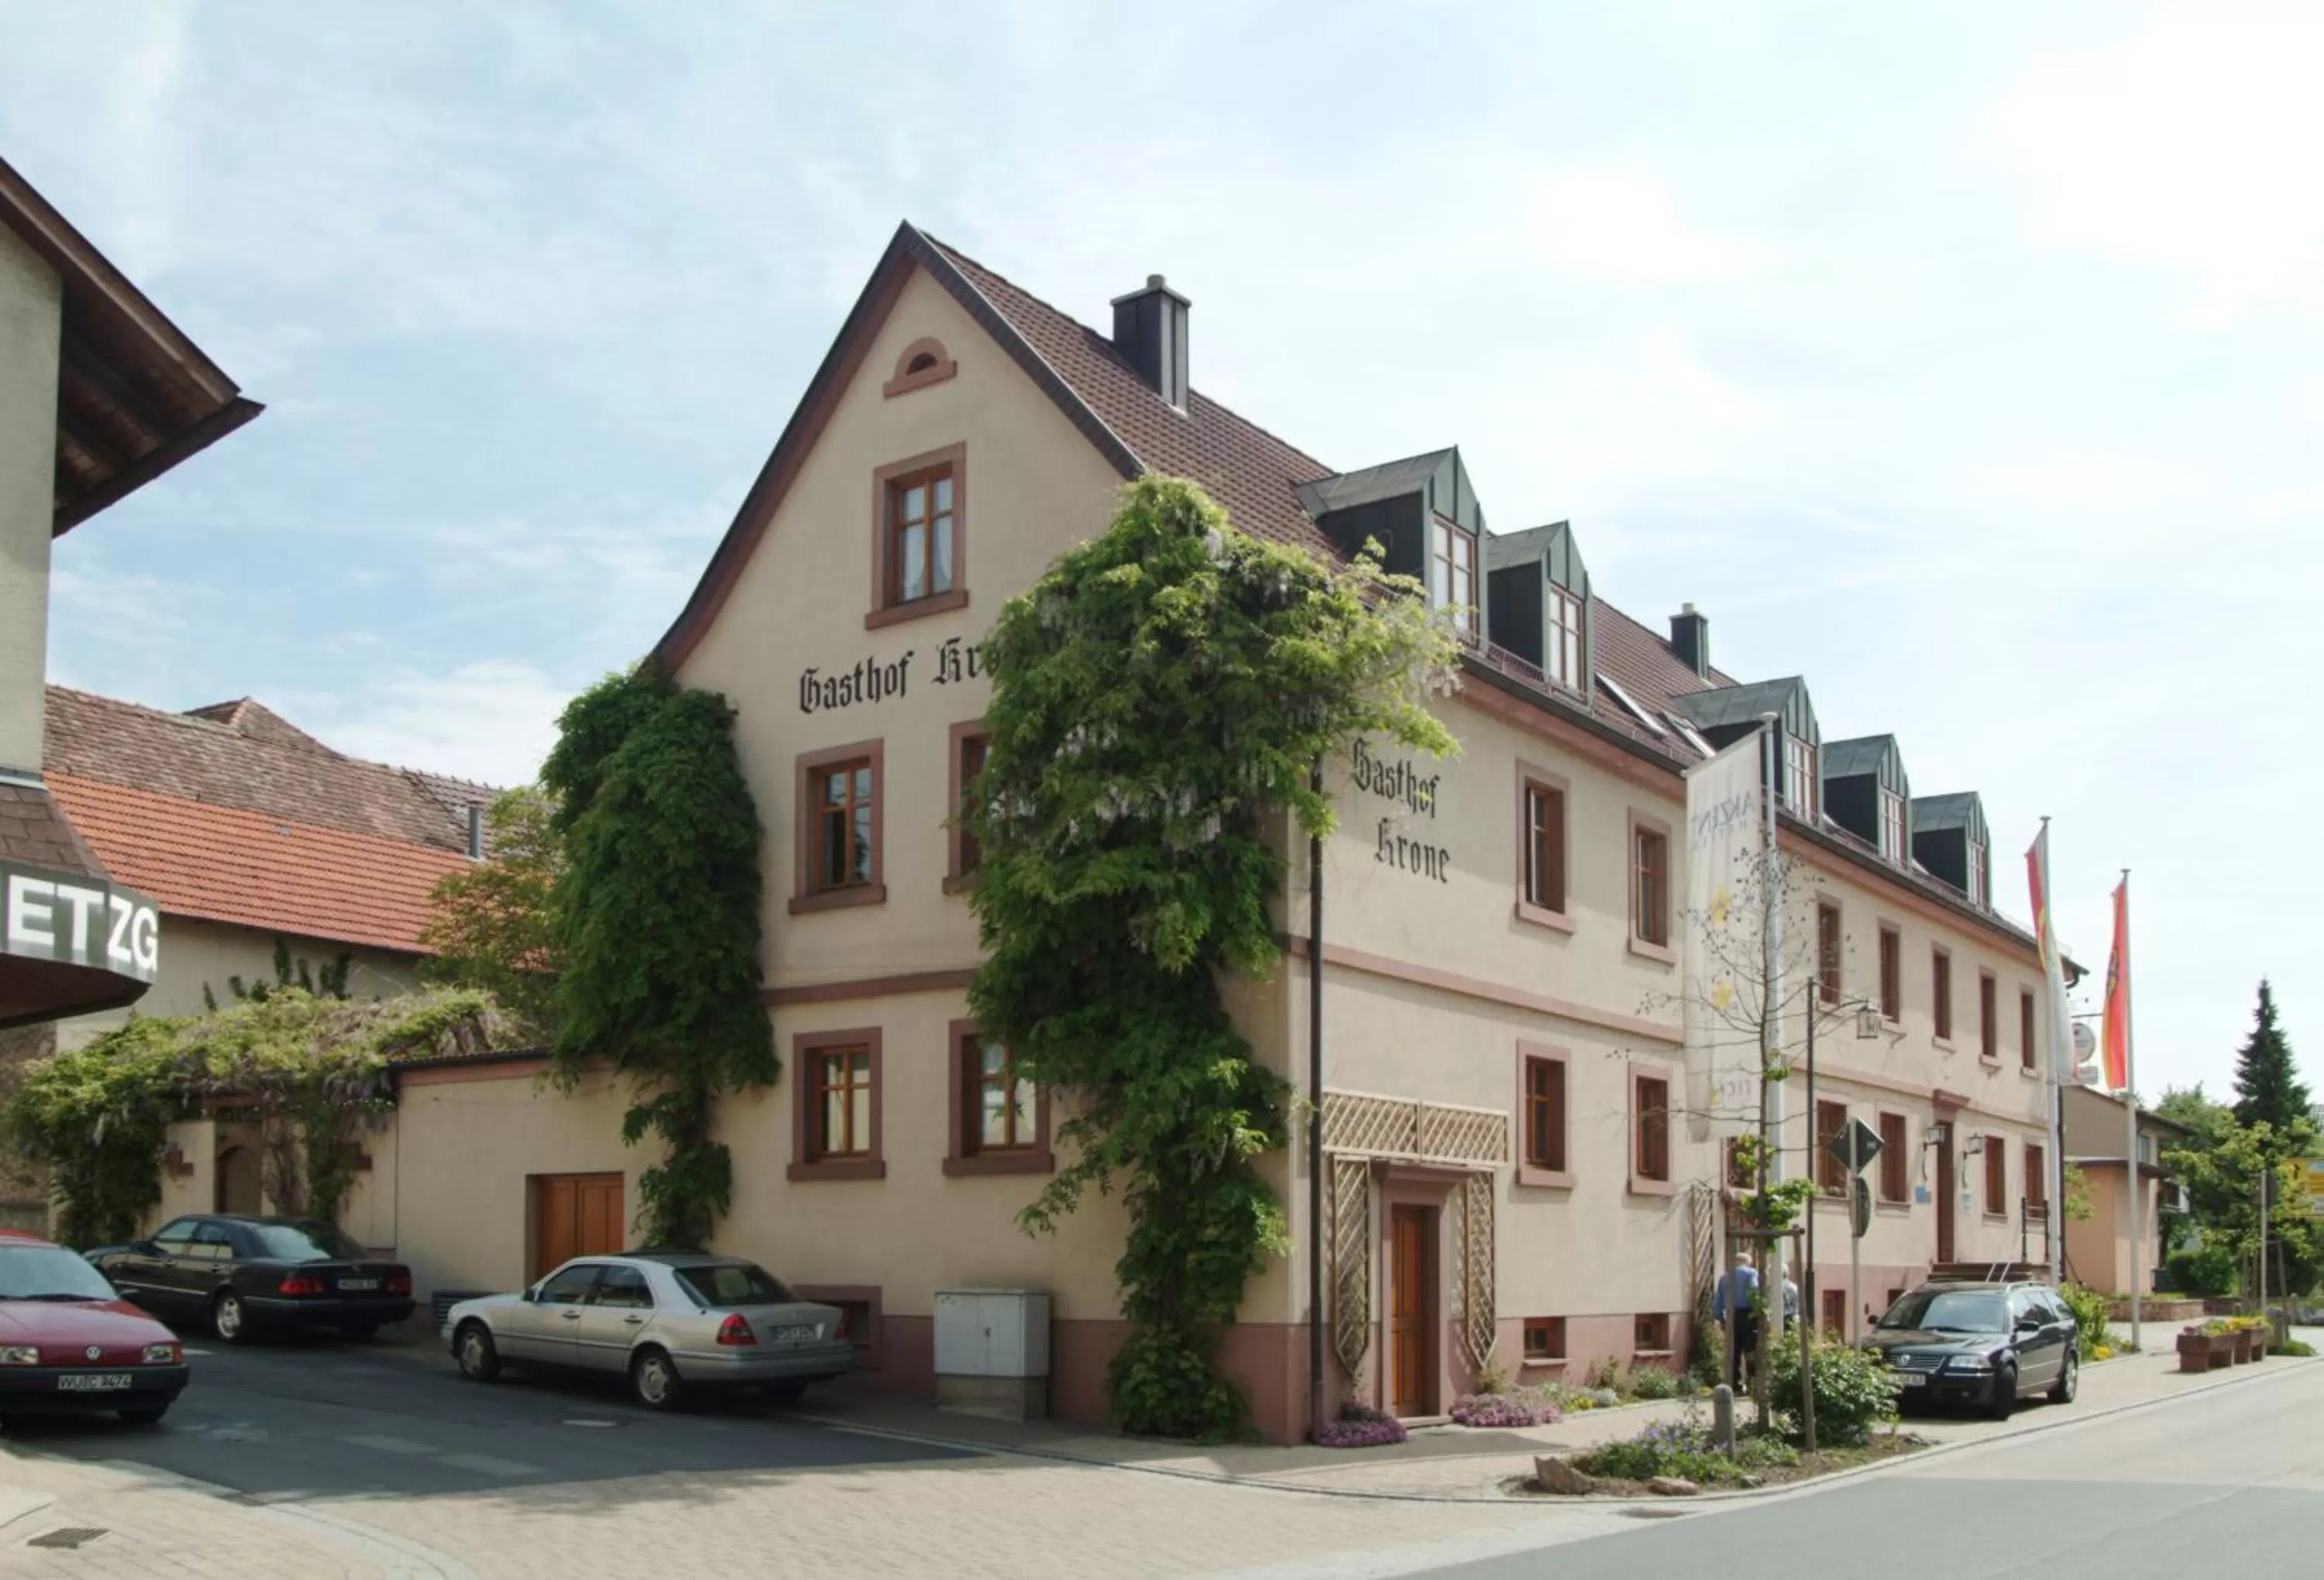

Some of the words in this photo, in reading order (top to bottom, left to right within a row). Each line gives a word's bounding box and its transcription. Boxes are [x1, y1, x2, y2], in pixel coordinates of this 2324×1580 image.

[799, 651, 914, 714] Gasthof
[1353, 737, 1440, 819] Gasthof
[1374, 817, 1450, 884] Krone
